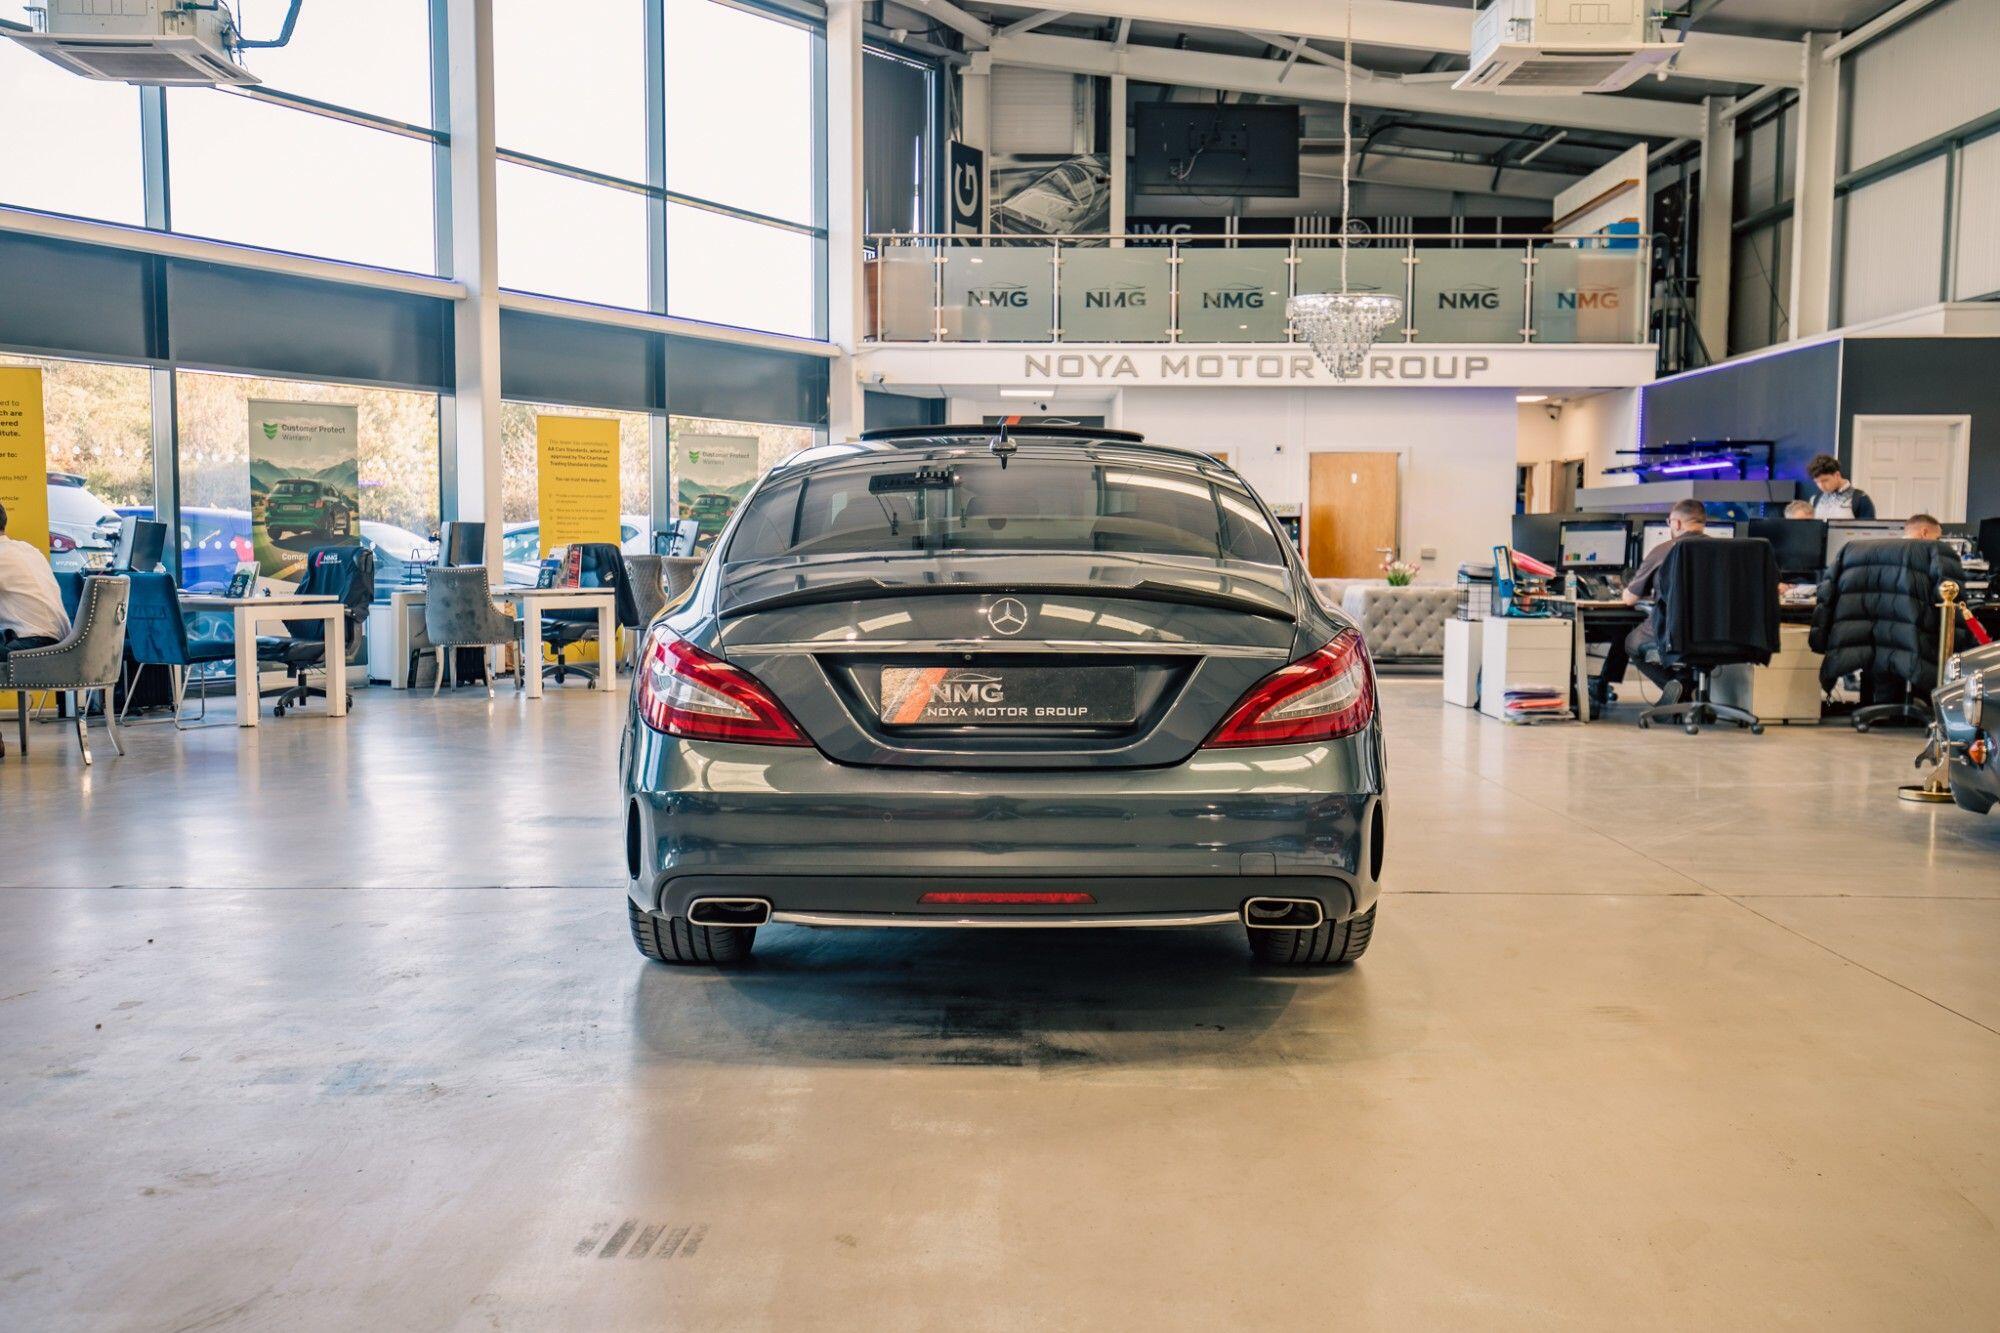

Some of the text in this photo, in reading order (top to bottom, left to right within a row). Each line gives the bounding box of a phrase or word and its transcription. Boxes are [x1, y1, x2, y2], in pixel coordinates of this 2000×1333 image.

[967, 290, 1028, 307] NMG
[1203, 292, 1264, 308] NMG
[1438, 292, 1499, 309] NMG
[1557, 292, 1619, 309] NMG
[1025, 354, 1139, 378] NOYA
[1161, 355, 1314, 379] MOTOR
[281, 424, 346, 434] Customer Protect
[281, 434, 312, 442] Warranty
[931, 684, 1004, 703] NMG
[927, 707, 1088, 717] NOYA MOTOR GROUP
